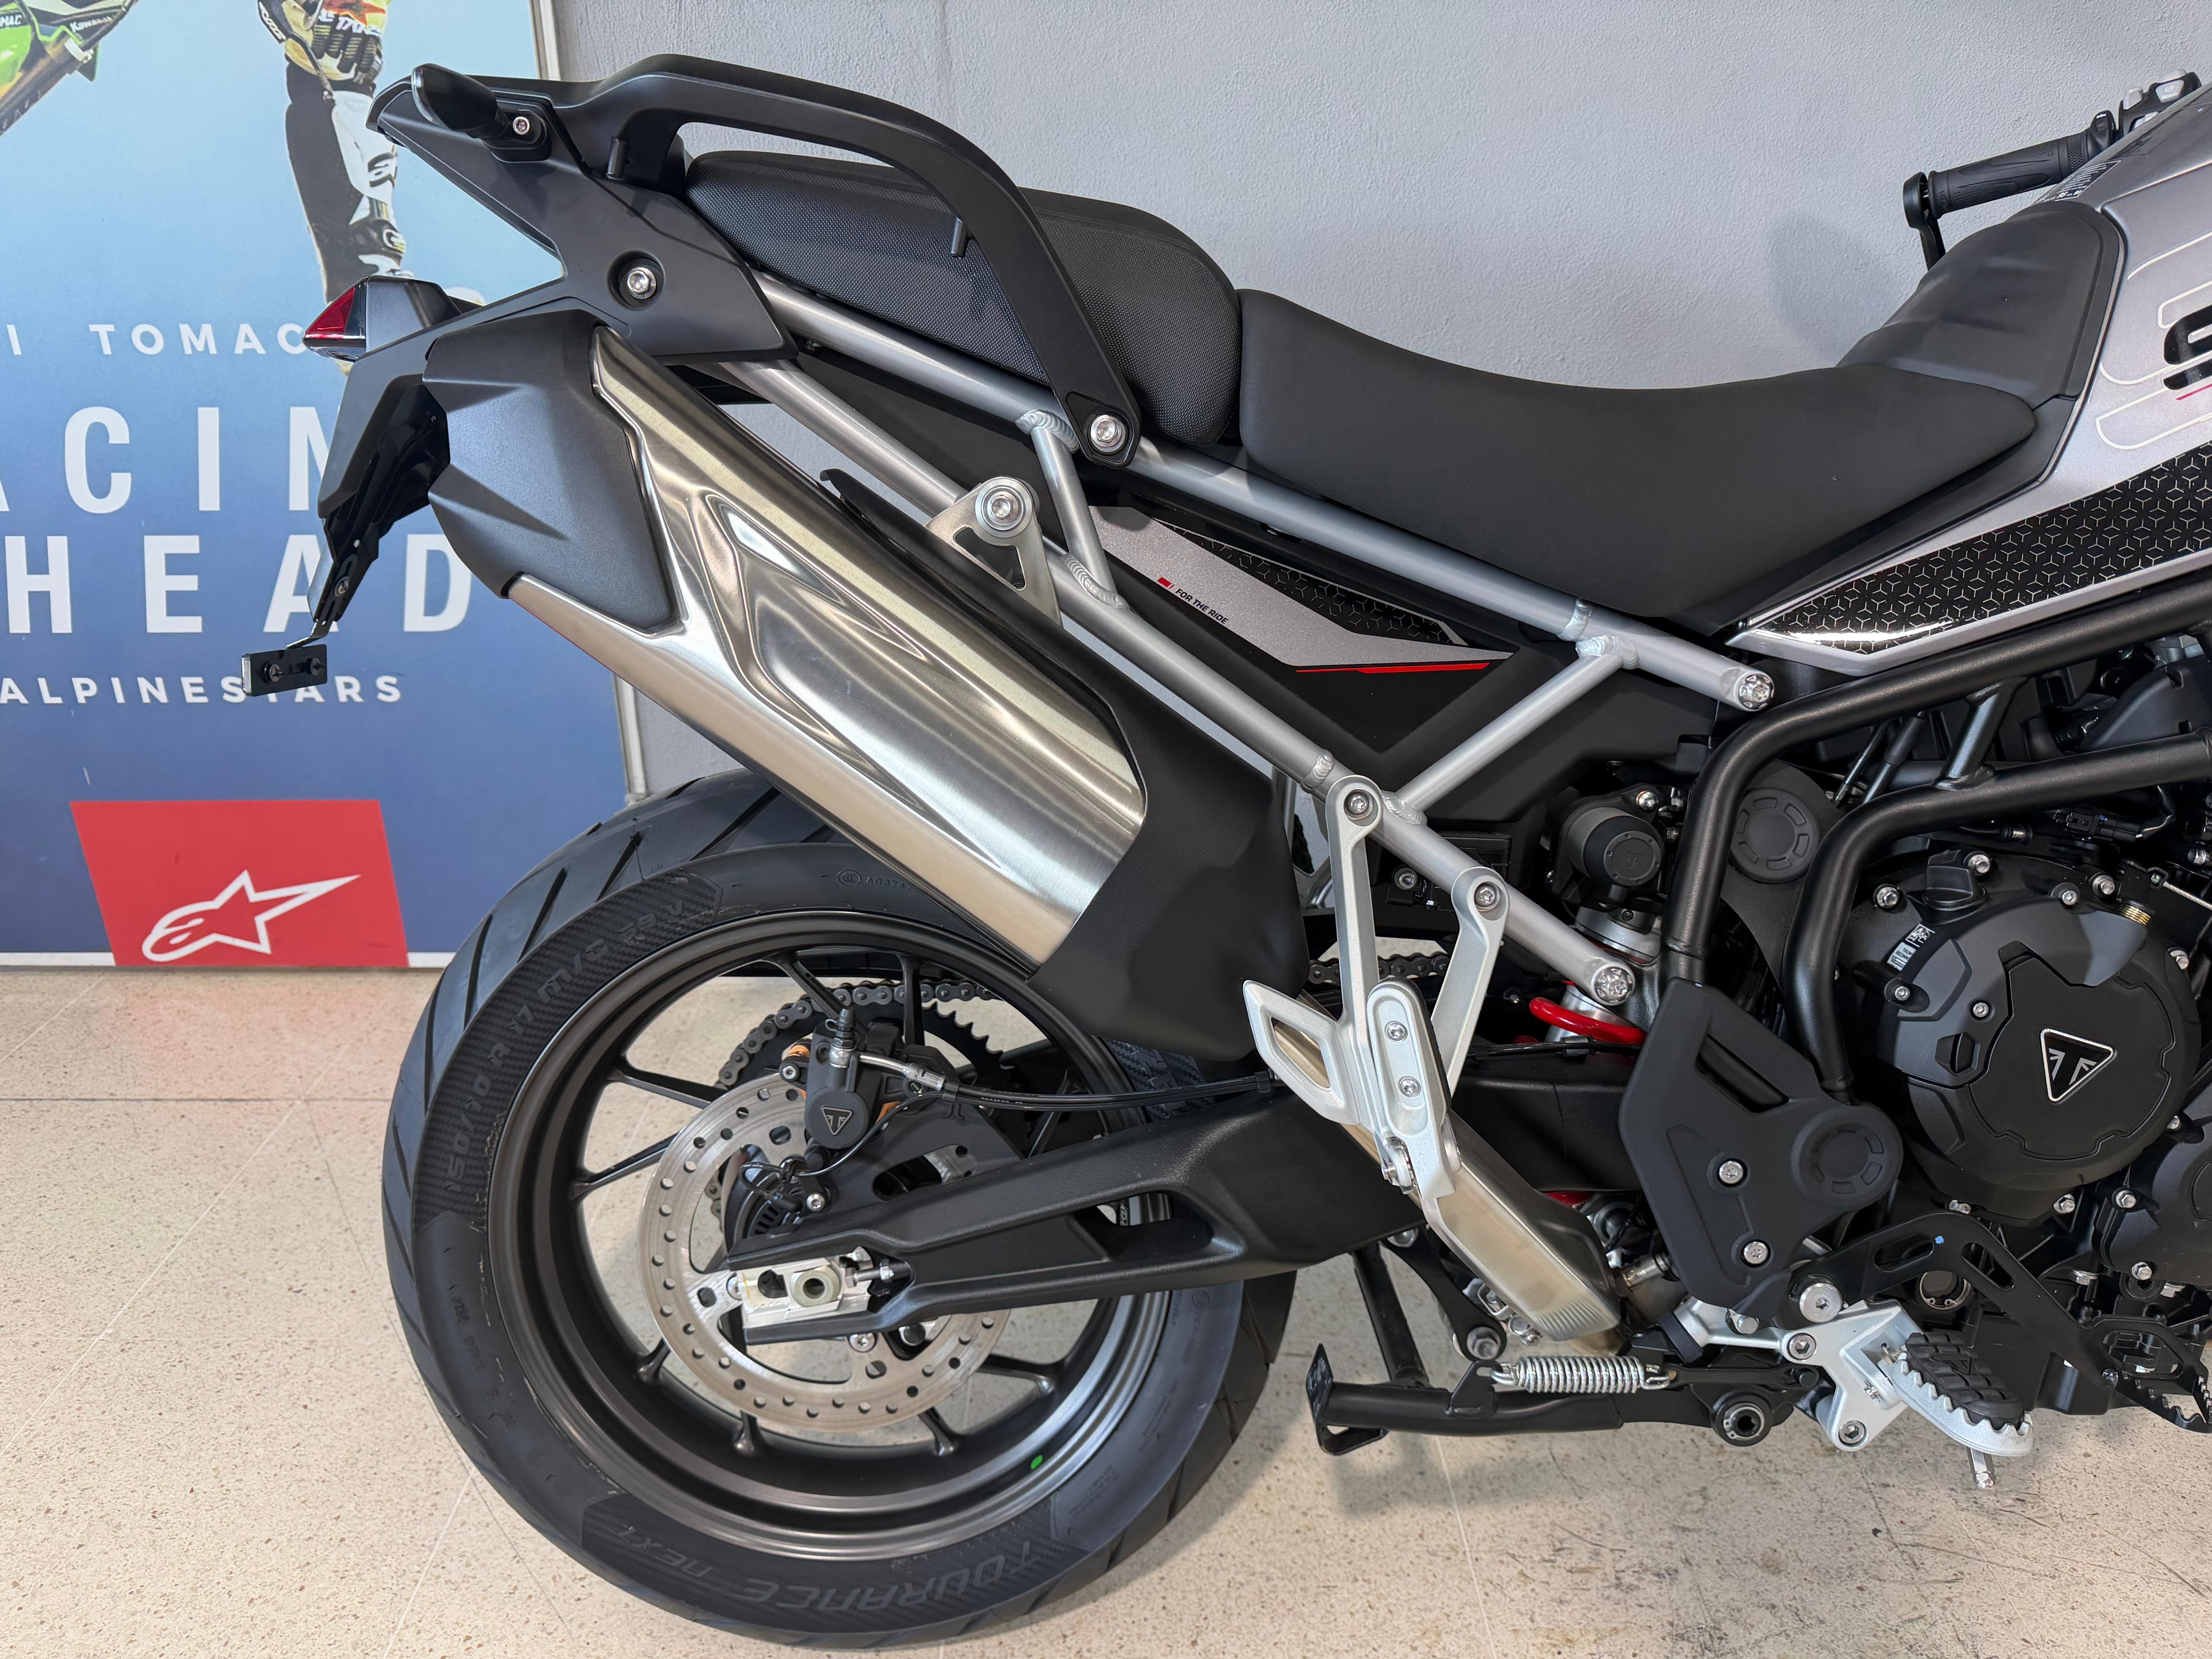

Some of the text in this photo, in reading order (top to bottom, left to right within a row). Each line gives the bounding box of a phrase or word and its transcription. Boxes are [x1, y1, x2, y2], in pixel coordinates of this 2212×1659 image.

[89, 322, 306, 355] TOMAC
[1176, 589, 1229, 624] FOR THE RIDE
[1, 675, 402, 704] ALPINESARS
[735, 1540, 1038, 1611] TOURANCE
